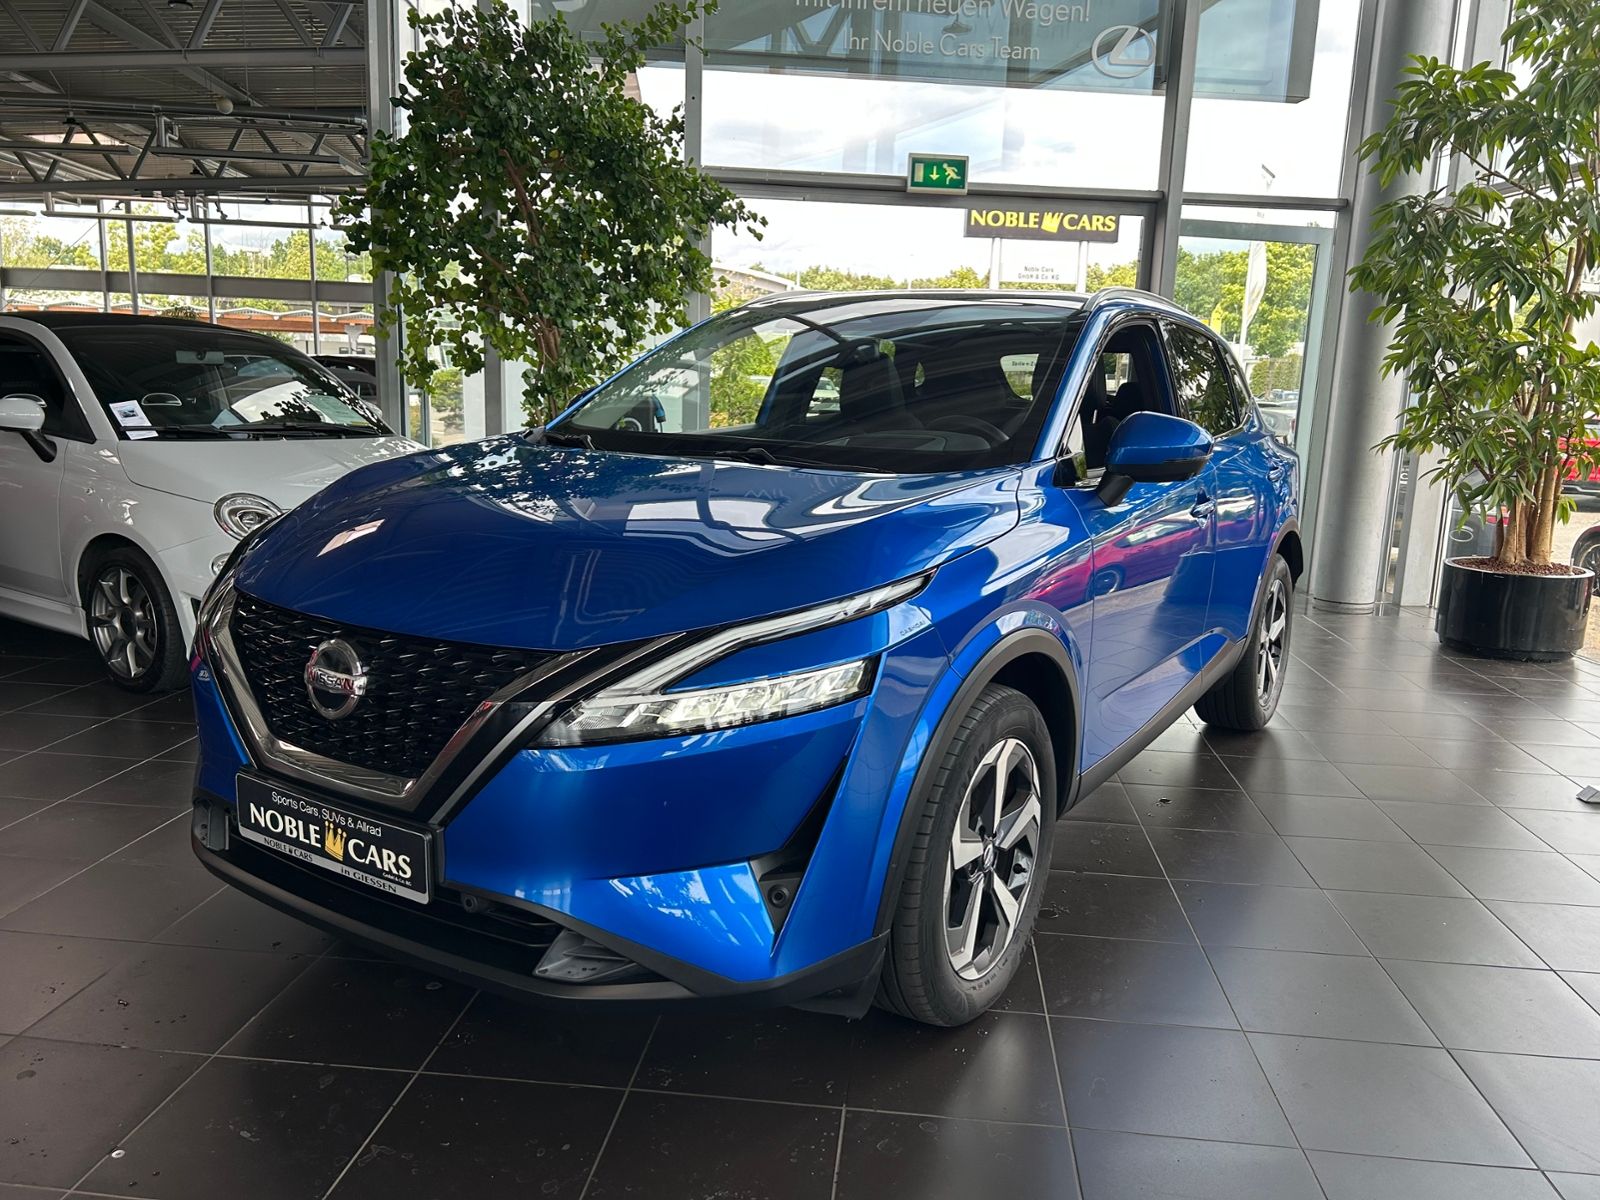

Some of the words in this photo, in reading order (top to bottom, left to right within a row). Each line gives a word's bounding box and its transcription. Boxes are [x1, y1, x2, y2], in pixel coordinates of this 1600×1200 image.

[918, 0, 992, 17] neuen
[1001, 0, 1091, 26] Wagen!
[844, 28, 869, 50] Ihr
[875, 29, 935, 54] Noble
[939, 33, 985, 57] Cars
[991, 36, 1040, 60] Team
[970, 209, 1040, 229] NOBLE
[1062, 213, 1117, 232] CARS
[271, 791, 299, 810] Sports
[299, 801, 321, 819] Cars,
[321, 808, 346, 826] SUVs
[347, 817, 355, 829] &
[356, 820, 382, 837] Allrad
[249, 802, 321, 848] NOBLE
[347, 838, 412, 879] CARS
[263, 837, 287, 853] NOBLE
[294, 848, 313, 862] CARS
[341, 865, 351, 876] in
[353, 869, 397, 893] GIESSEN
